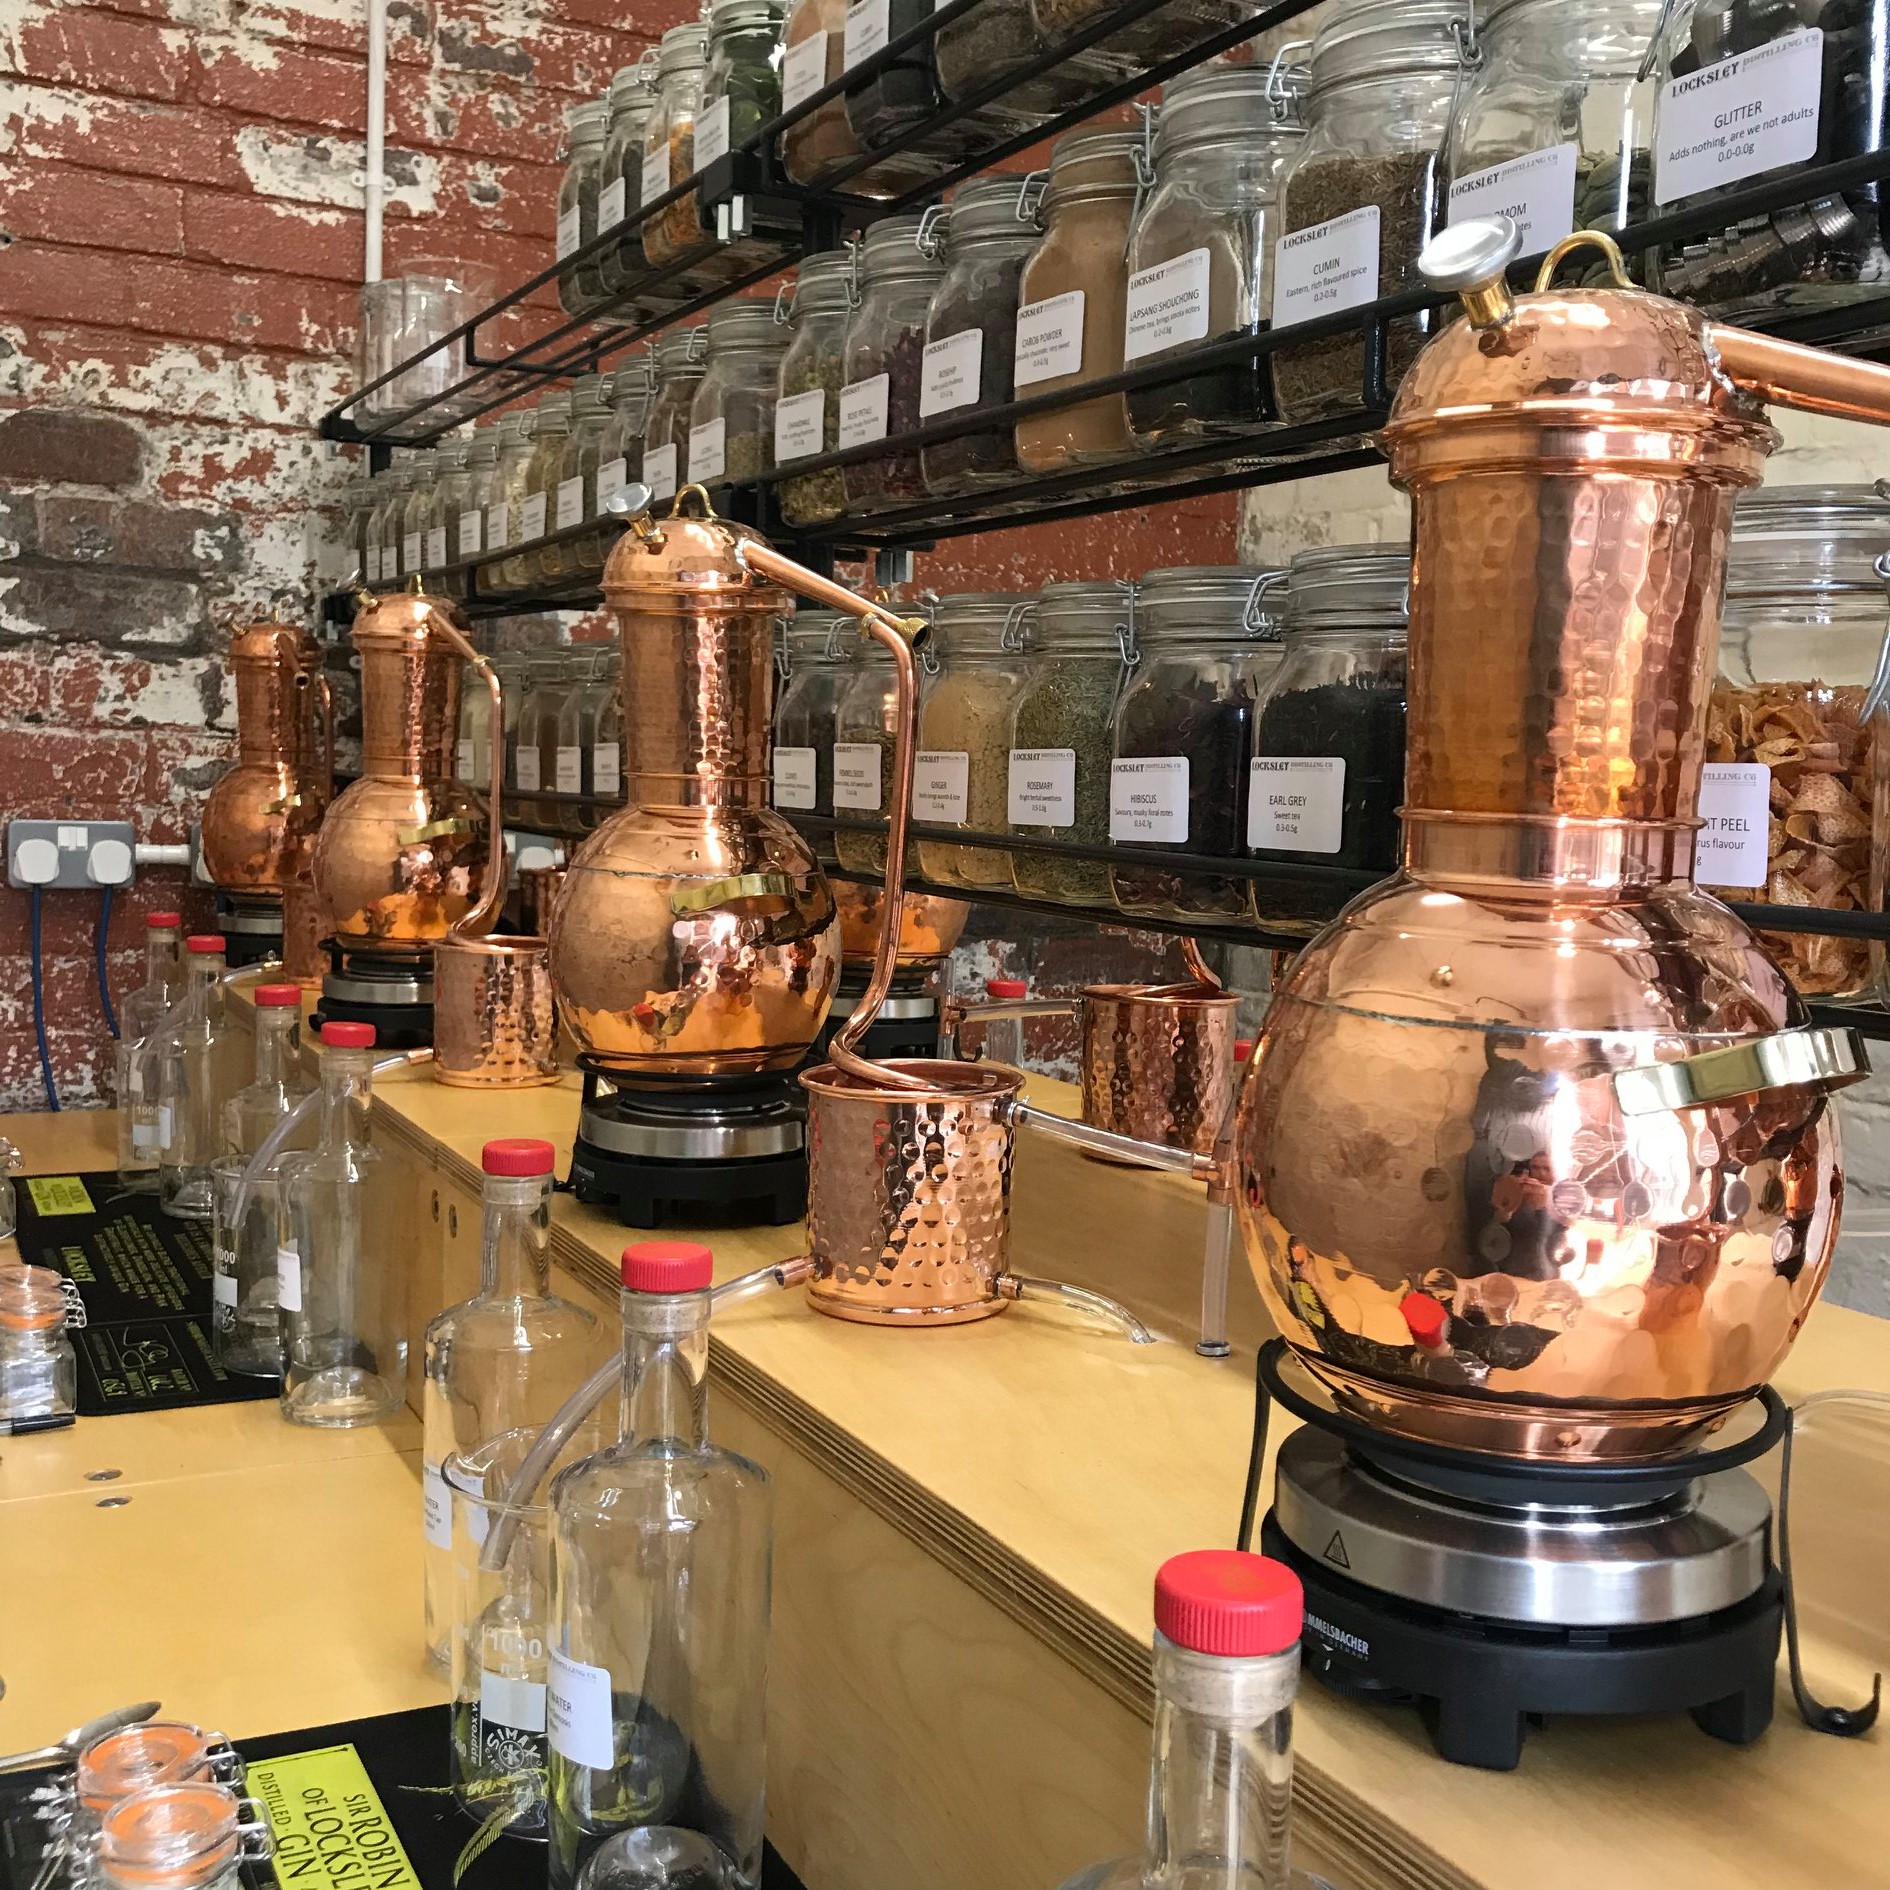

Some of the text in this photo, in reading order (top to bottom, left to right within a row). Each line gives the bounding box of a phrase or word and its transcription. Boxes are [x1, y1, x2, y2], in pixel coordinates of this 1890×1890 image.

[1672, 62, 1740, 98] LOCKSLEY
[1714, 101, 1763, 129] GLITTER
[1669, 147, 1690, 162] Adds
[1730, 130, 1745, 142] are
[1747, 122, 1761, 136] we
[1763, 117, 1779, 130] not
[1781, 107, 1814, 124] adults
[1718, 142, 1755, 163] 0.0-0.0g
[1451, 172, 1500, 199] LOCKSLEY
[1283, 226, 1328, 250] LOCKSLEY
[1313, 257, 1341, 275] CUMIN
[1130, 269, 1165, 291] LOCKSLEY
[1286, 266, 1368, 298] Eastern, rich flavoured spice
[1130, 288, 1200, 322] LAPSANG SHOUCHONG
[1022, 328, 1063, 349] CAROB POWDER
[1013, 752, 1041, 761] LOCKSLEY
[1252, 761, 1289, 771] LOCKSLEY
[1112, 763, 1145, 773] LOCKSLEY
[1026, 781, 1054, 791] ROSEMARY
[1130, 794, 1157, 804] HIBISCUS
[1269, 795, 1307, 806] EARL GREY
[1274, 811, 1301, 820] Sweet tea
[1720, 818, 1751, 832] PEEL
[1712, 837, 1745, 850] flavour
[491, 1629, 543, 1660] 1000
[486, 1727, 541, 1760] SIMAX
[301, 1787, 329, 1806] OF
[257, 1771, 322, 1880] DISTILLED GIN
[343, 1793, 411, 1889] SIR ROBIN
